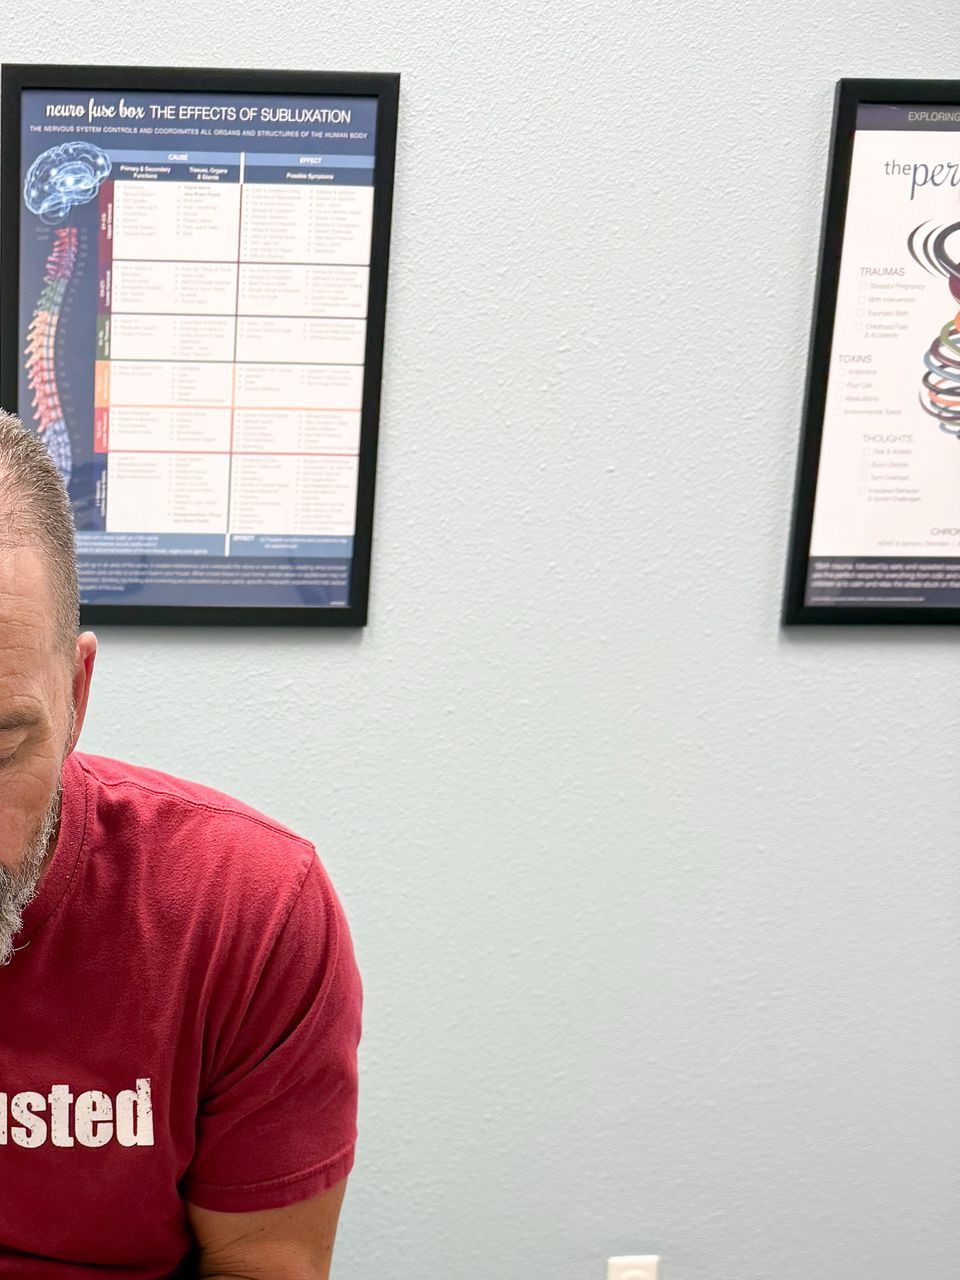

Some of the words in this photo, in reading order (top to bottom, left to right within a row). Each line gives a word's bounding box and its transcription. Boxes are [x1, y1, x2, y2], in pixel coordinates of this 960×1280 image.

[46, 103, 86, 117] neuro
[88, 98, 117, 123] fuse
[119, 98, 145, 119] box
[149, 105, 176, 119] THE
[179, 105, 236, 120] EFFECTS
[239, 106, 259, 121] OF
[260, 107, 352, 123] SUBLUXATION
[907, 111, 960, 122] EXPLORING
[29, 125, 42, 133] THE
[43, 125, 75, 133] NERVOUS
[76, 126, 102, 134] SYSTEM
[103, 126, 138, 134] CONTROLS
[154, 128, 200, 136] COORDINATES
[200, 128, 213, 136] ALL
[242, 129, 256, 137] AND
[257, 130, 300, 138] STRUCTURES
[301, 130, 310, 138] OF
[324, 131, 348, 139] HUMAN
[349, 132, 368, 140] BODY
[884, 159, 912, 175] the
[910, 161, 960, 201] per
[859, 267, 906, 277] TRAUMAS
